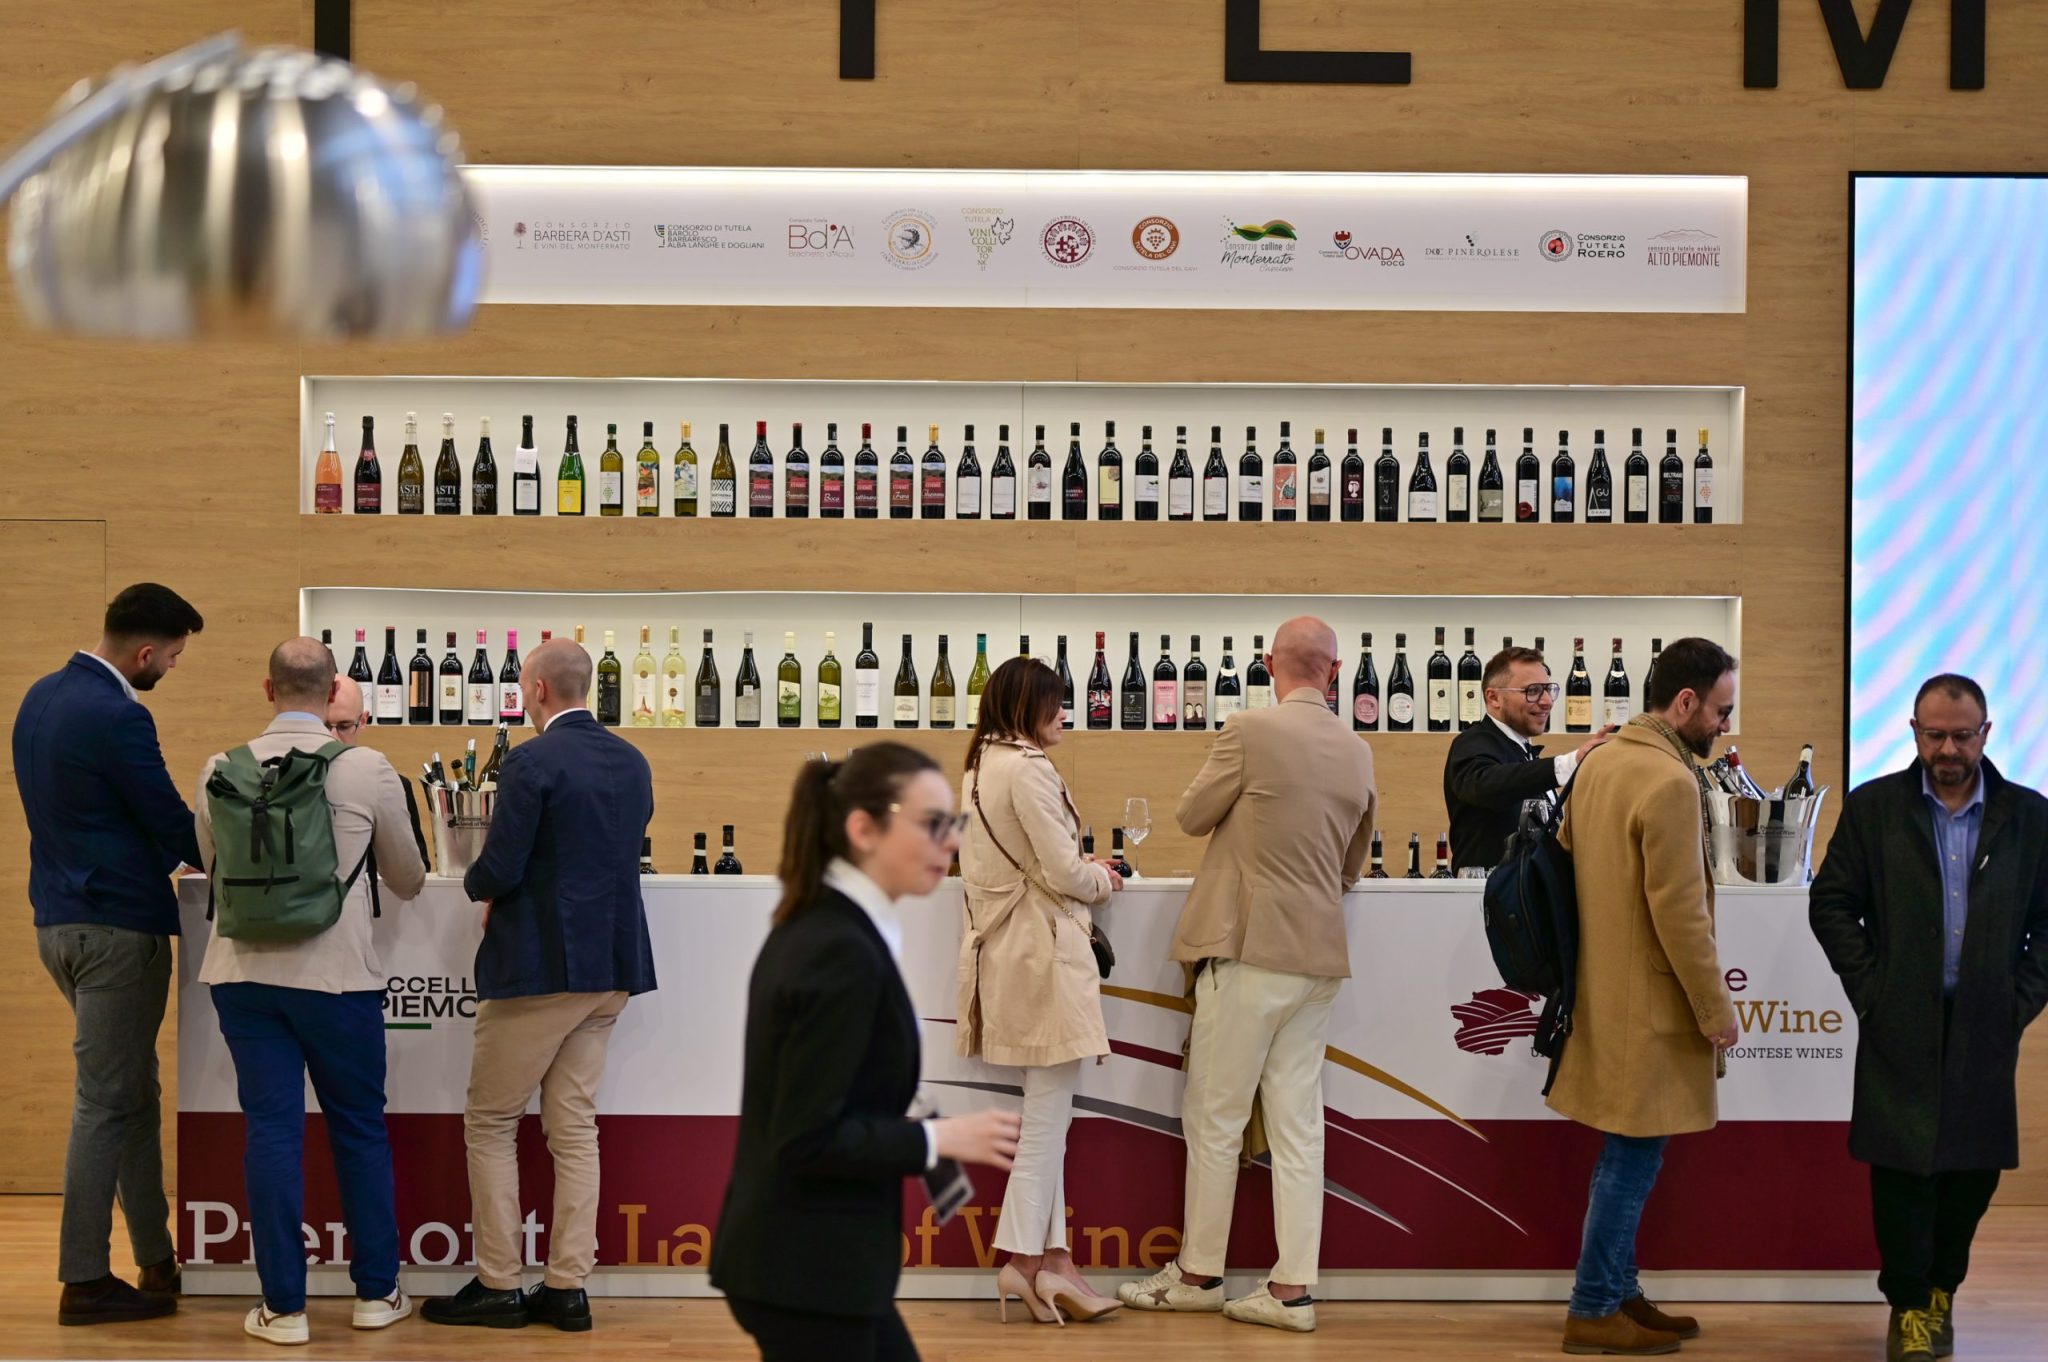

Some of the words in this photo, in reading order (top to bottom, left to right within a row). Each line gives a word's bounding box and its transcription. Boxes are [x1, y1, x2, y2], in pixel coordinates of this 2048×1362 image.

[534, 221, 631, 229] CONSORZIO
[667, 224, 713, 232] CONSORZIO
[714, 224, 723, 232] DI
[724, 224, 752, 232] TUTELA
[1139, 218, 1173, 230] CONSORZIO
[534, 230, 590, 242] BARBERA
[592, 230, 631, 242] D'ASTI
[968, 228, 991, 237] VINI
[1577, 233, 1626, 242] CONSORZIO
[972, 237, 997, 245] COLLI
[1225, 242, 1258, 251] Consorzio
[1261, 241, 1283, 251] colline
[1286, 242, 1295, 251] del
[1577, 241, 1625, 249] TUTELA
[976, 245, 993, 253] TOR
[1134, 240, 1153, 258] TUTELA
[1344, 246, 1405, 260] OVADA
[1448, 248, 1520, 257] PINEROLESE
[1577, 249, 1625, 258] ROERO
[1220, 250, 1295, 269] Monferrato
[1647, 252, 1670, 266] ALTO
[1672, 252, 1721, 267] PIEMONTE
[399, 484, 420, 494] ASTI
[435, 485, 456, 495] ASTI
[387, 976, 477, 994] CCELL
[1733, 1000, 1843, 1034] Wine
[1724, 1047, 1793, 1059] MONTESE
[1793, 1047, 1843, 1059] WINES
[618, 1204, 712, 1267] La
